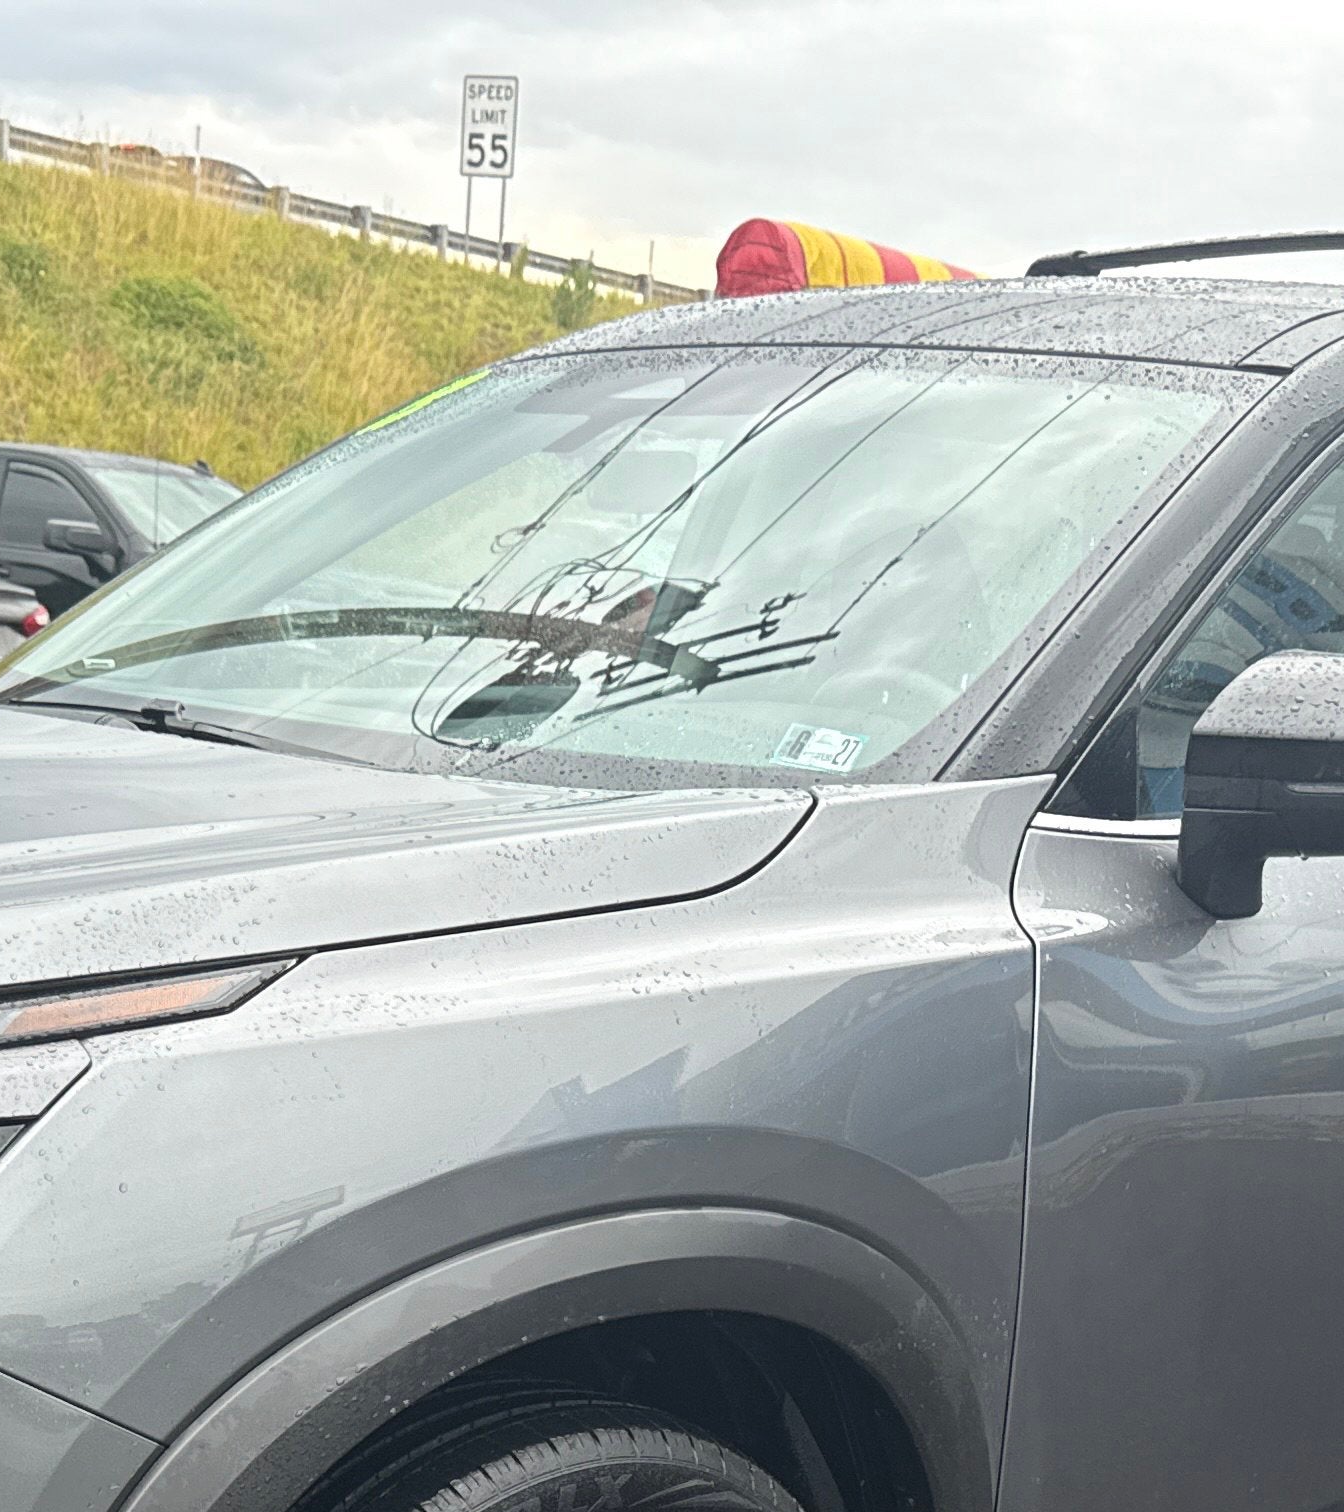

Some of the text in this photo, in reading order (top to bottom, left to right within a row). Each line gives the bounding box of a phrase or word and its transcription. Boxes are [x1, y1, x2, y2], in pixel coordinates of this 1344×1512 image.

[468, 84, 513, 101] SPEED
[471, 109, 507, 124] LIMIT
[466, 132, 508, 168] 55
[832, 738, 861, 766] 27
